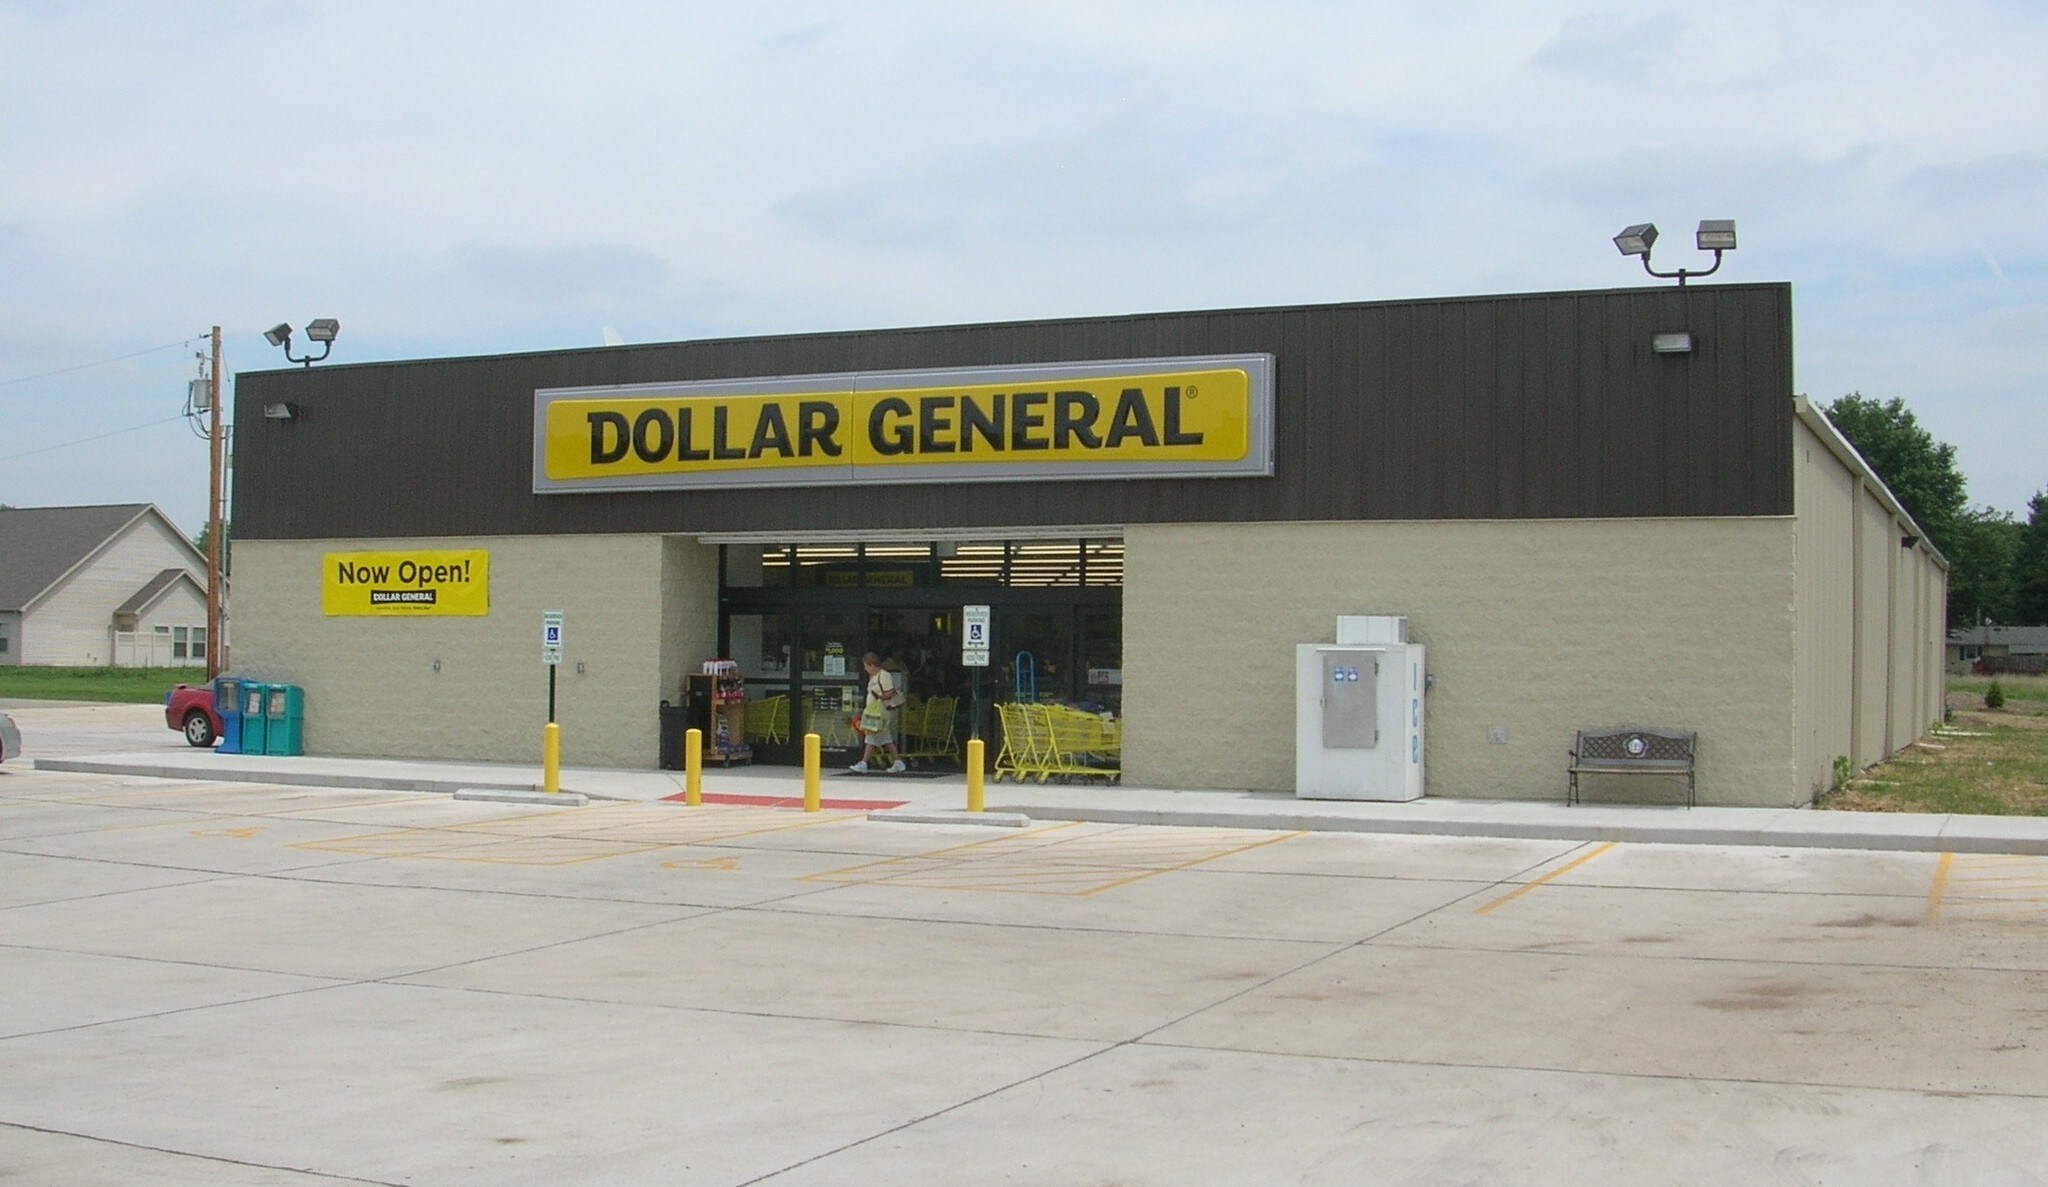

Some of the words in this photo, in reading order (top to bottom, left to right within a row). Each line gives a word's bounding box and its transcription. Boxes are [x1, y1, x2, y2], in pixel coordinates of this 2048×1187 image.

[588, 401, 843, 465] DOLLAR
[867, 386, 1204, 456] GENERAL
[338, 562, 391, 584] Now
[398, 559, 470, 588] Open!
[373, 593, 401, 602] DOLLAR
[401, 592, 433, 601] GENERAL
